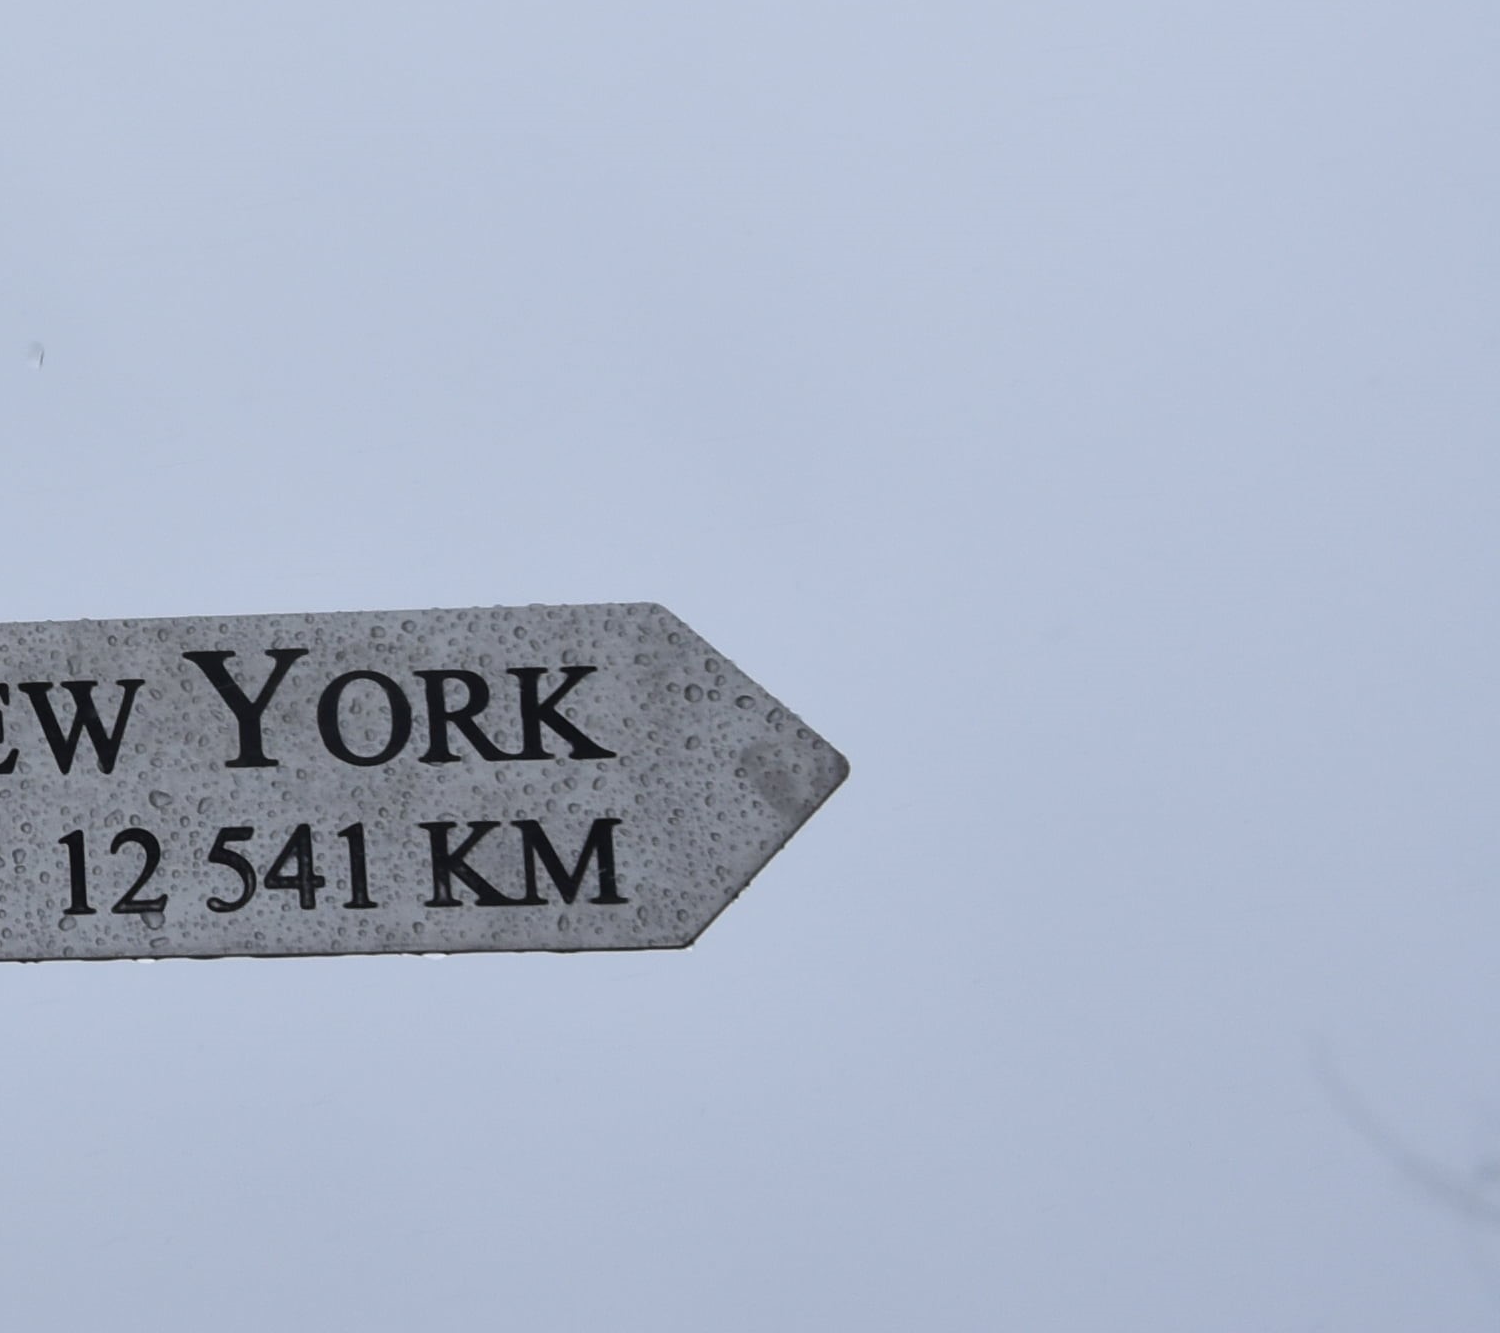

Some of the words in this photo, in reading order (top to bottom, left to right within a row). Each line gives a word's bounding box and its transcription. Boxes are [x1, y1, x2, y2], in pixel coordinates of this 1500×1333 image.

[181, 647, 618, 769] YORK
[57, 826, 169, 917] 12
[205, 821, 379, 914] 541
[417, 816, 630, 909] KM
